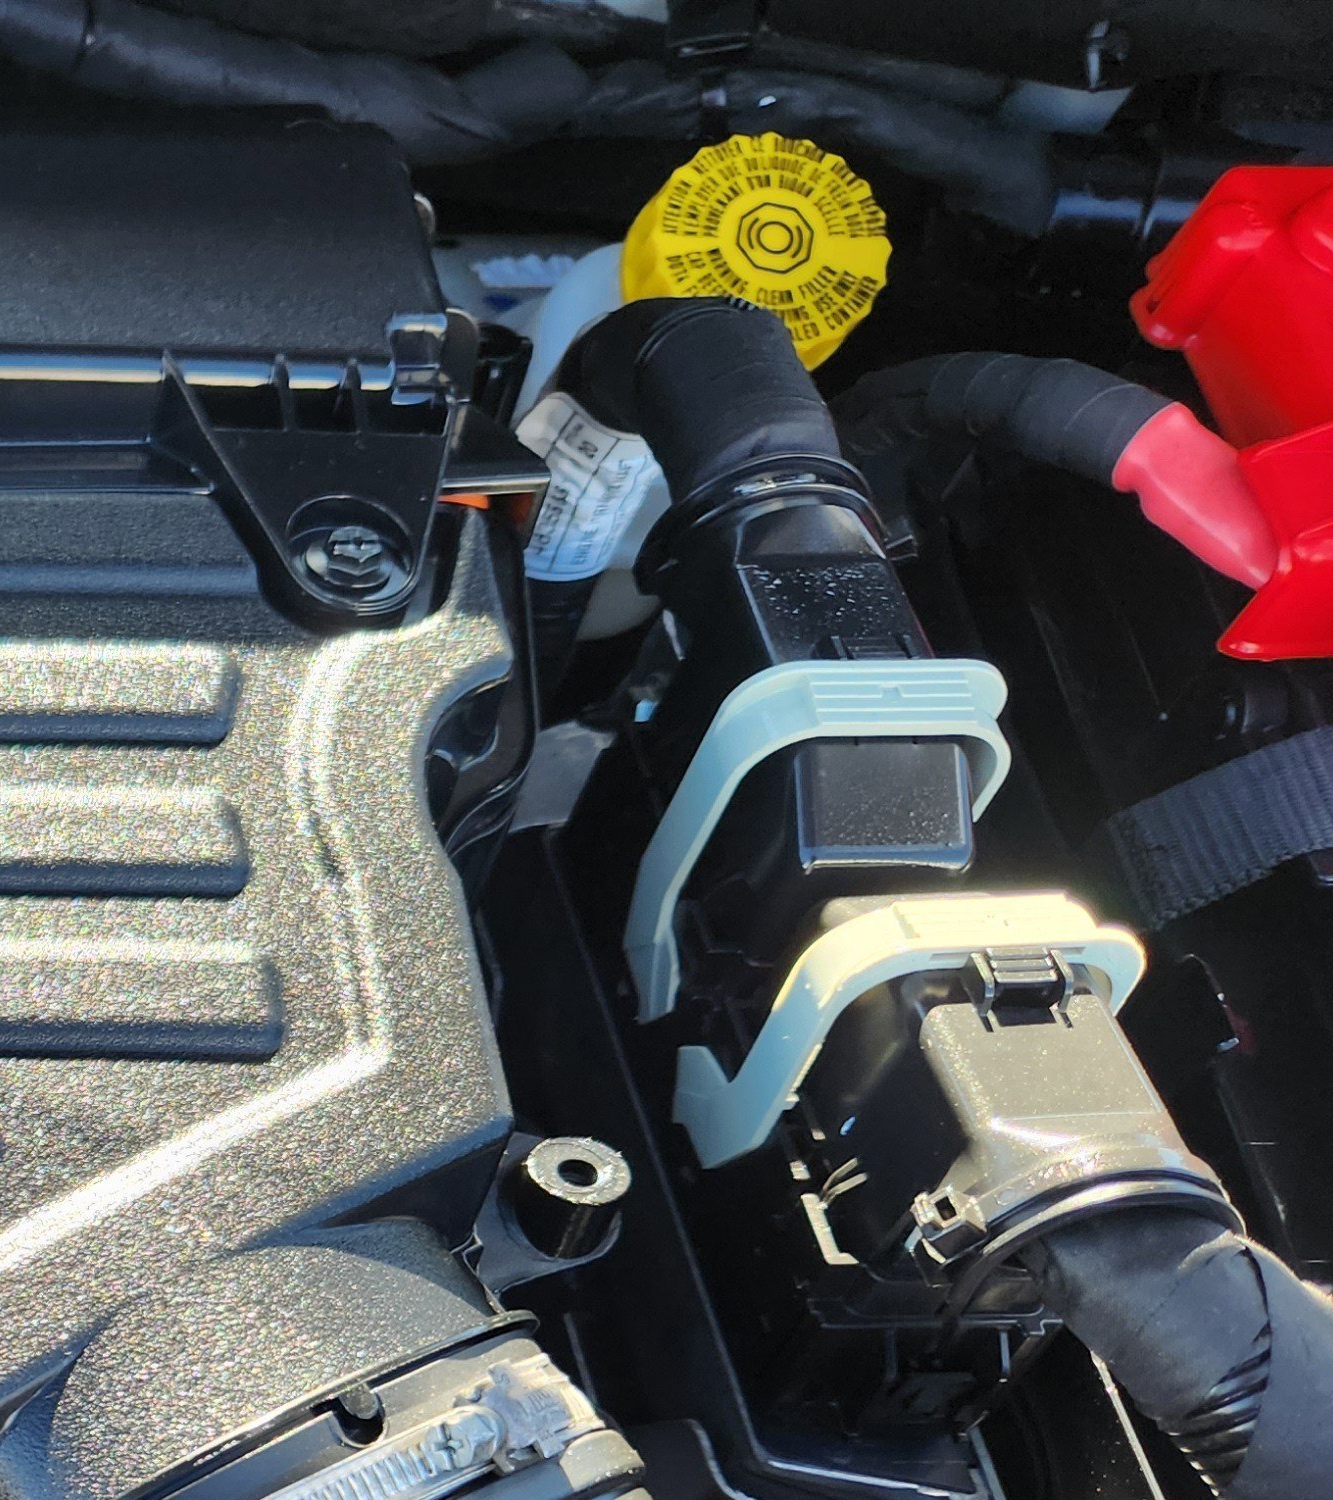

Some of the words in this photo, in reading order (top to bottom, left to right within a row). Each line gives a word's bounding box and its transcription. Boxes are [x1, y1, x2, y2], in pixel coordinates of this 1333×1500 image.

[662, 180, 692, 234] ATTENTION
[693, 140, 743, 175] NETTOYER
[718, 163, 741, 182] QUE
[703, 182, 744, 238] PROVENANT
[665, 253, 691, 285] DOT4
[823, 275, 879, 332] CONTAINER
[684, 250, 707, 271] CAP
[812, 289, 839, 314] USE
[832, 269, 860, 299] ONLY
[755, 286, 795, 305] CLEAN
[797, 264, 838, 300] FILLER
